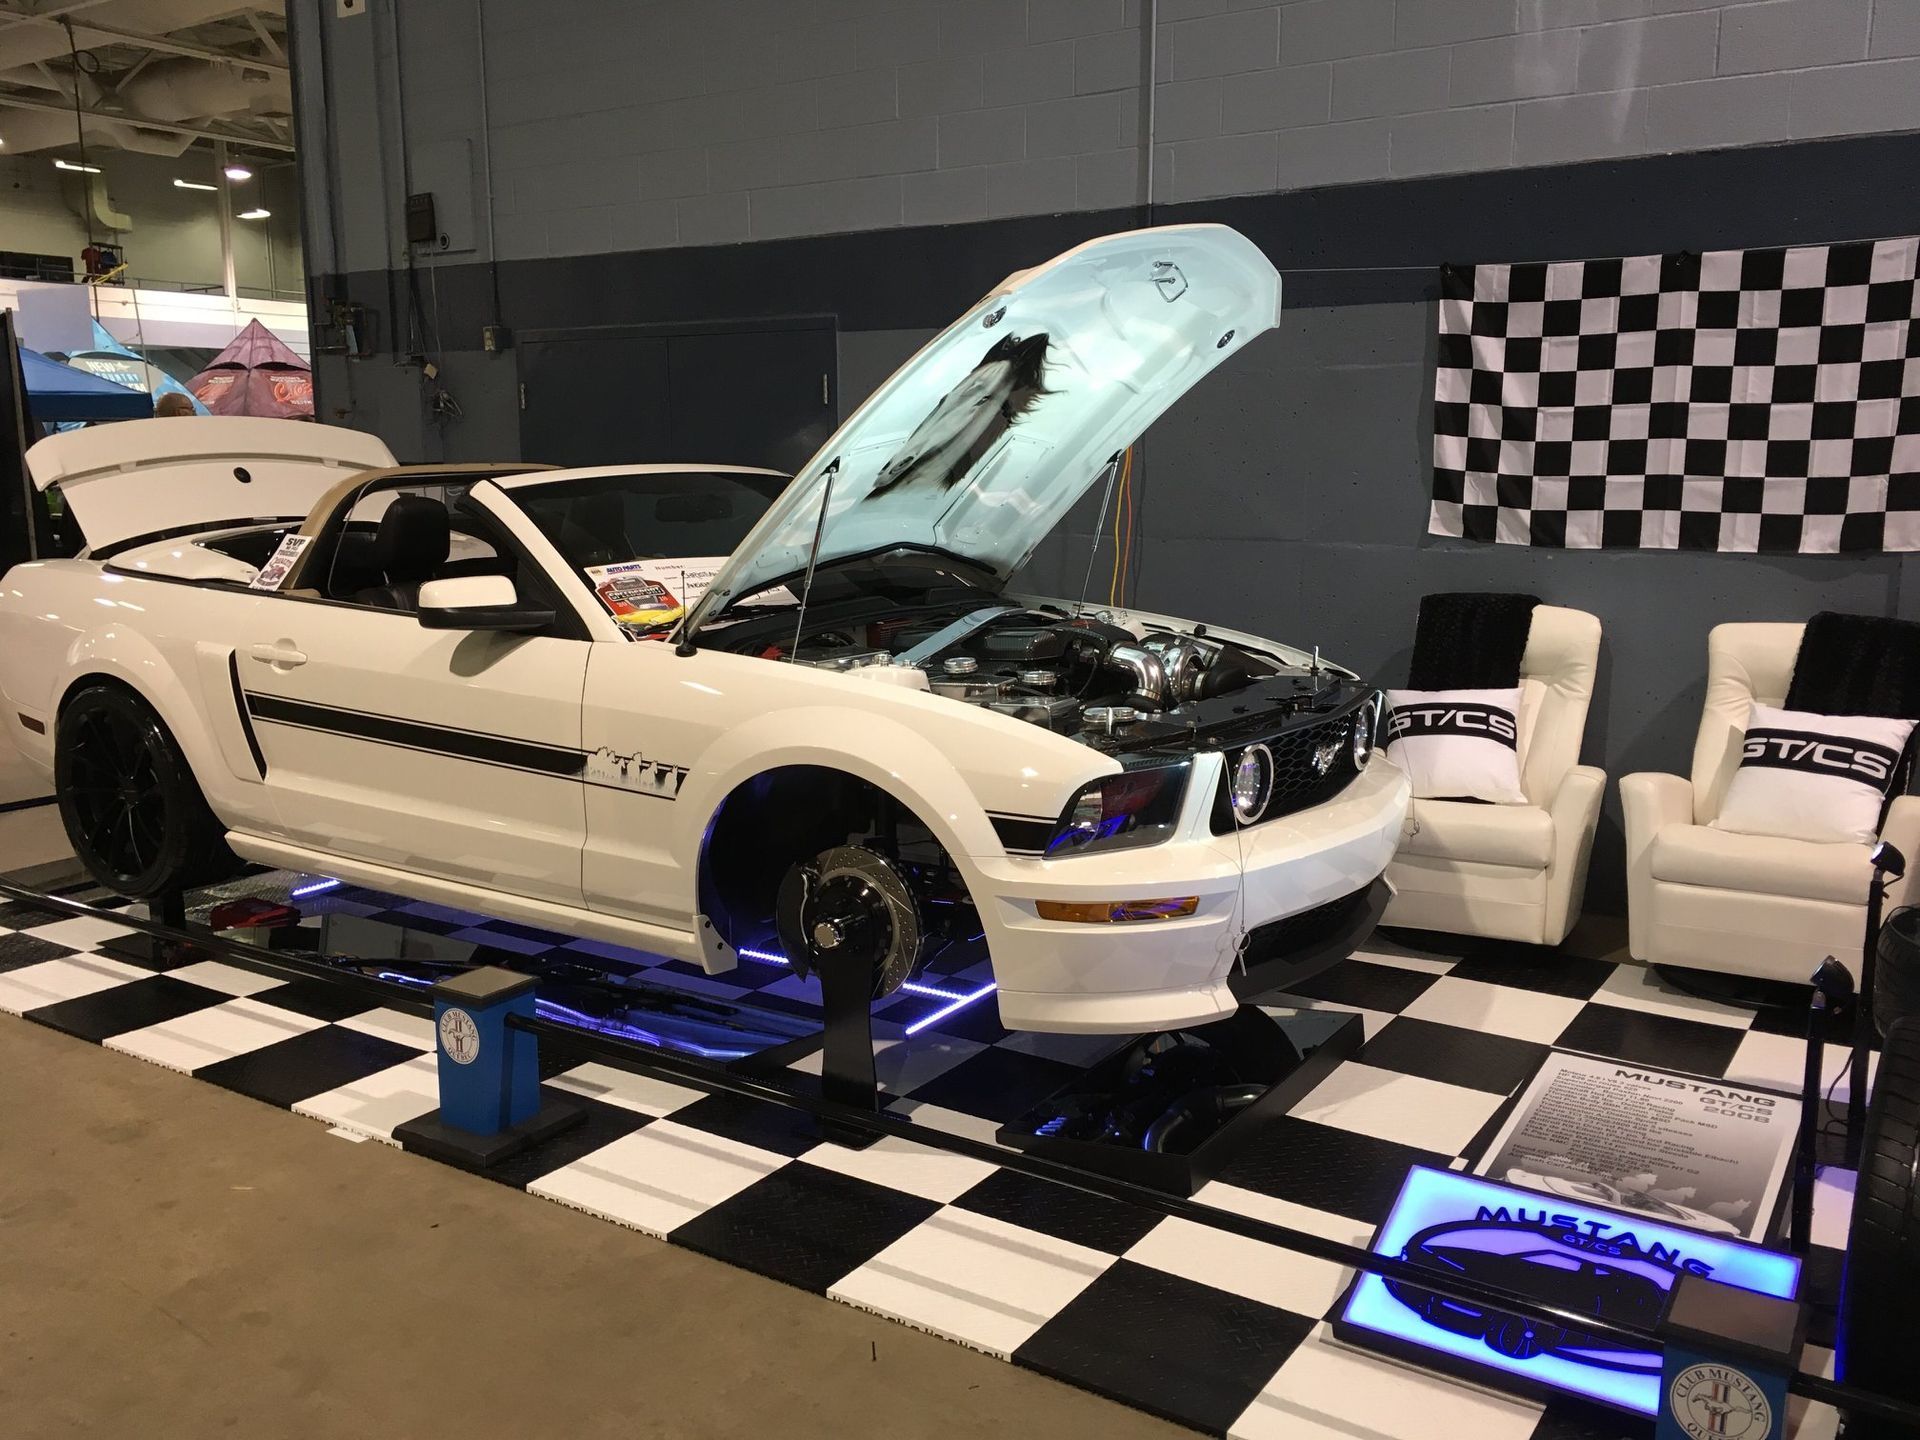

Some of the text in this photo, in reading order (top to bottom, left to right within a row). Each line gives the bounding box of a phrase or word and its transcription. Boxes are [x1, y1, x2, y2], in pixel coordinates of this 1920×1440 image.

[85, 361, 116, 373] NEW
[286, 537, 306, 547] SVP
[622, 564, 641, 572] PARTS
[1387, 709, 1515, 740] GT/CS
[1615, 1069, 1777, 1108] MUSTANG
[1699, 1097, 1773, 1117] GT/CS
[1703, 1106, 1770, 1124] 2008
[1476, 1206, 1714, 1279] MUSTANG
[1562, 1234, 1622, 1256] GT/CS
[1676, 1368, 1765, 1423] CLUB MUSTANG
